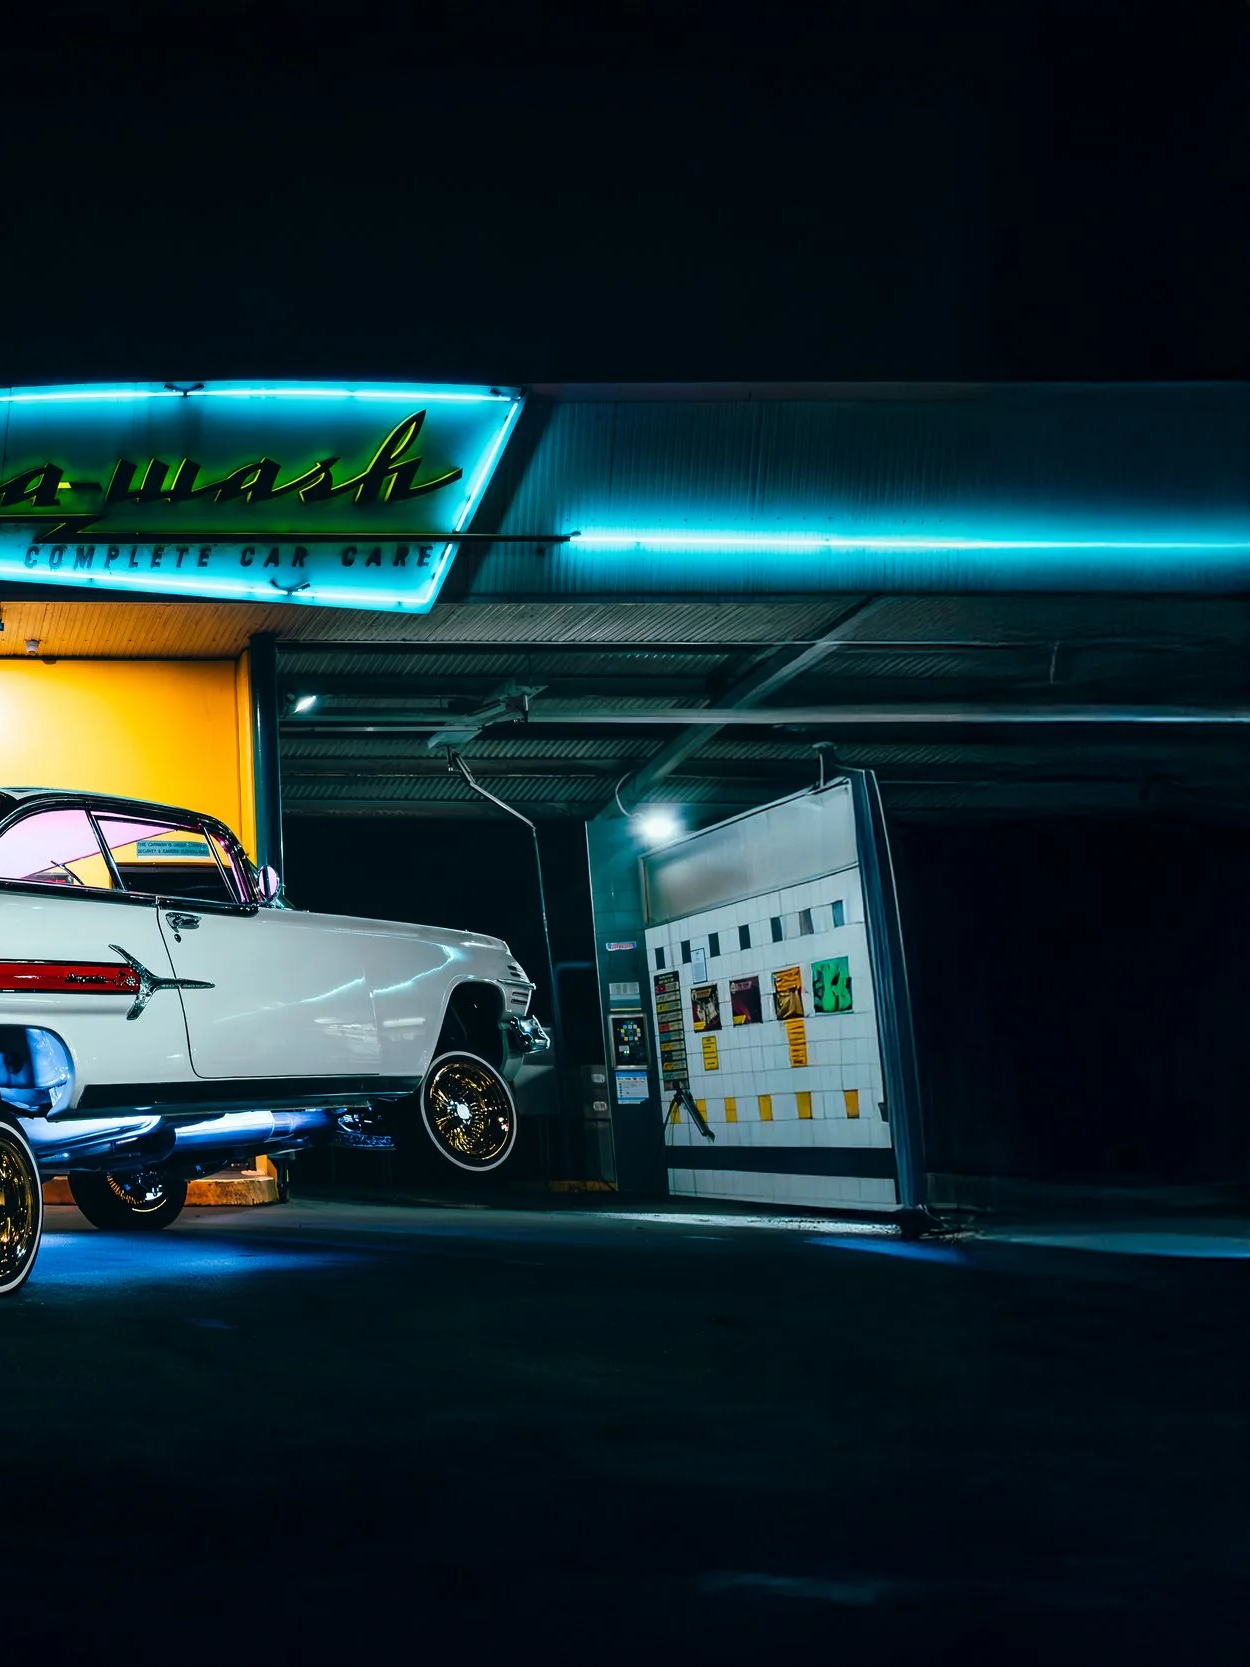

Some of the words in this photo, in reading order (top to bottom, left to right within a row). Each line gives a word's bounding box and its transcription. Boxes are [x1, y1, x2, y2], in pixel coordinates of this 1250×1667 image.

[24, 545, 212, 569] COMPLETE
[240, 546, 308, 567] CAR
[341, 545, 434, 567] CARE
